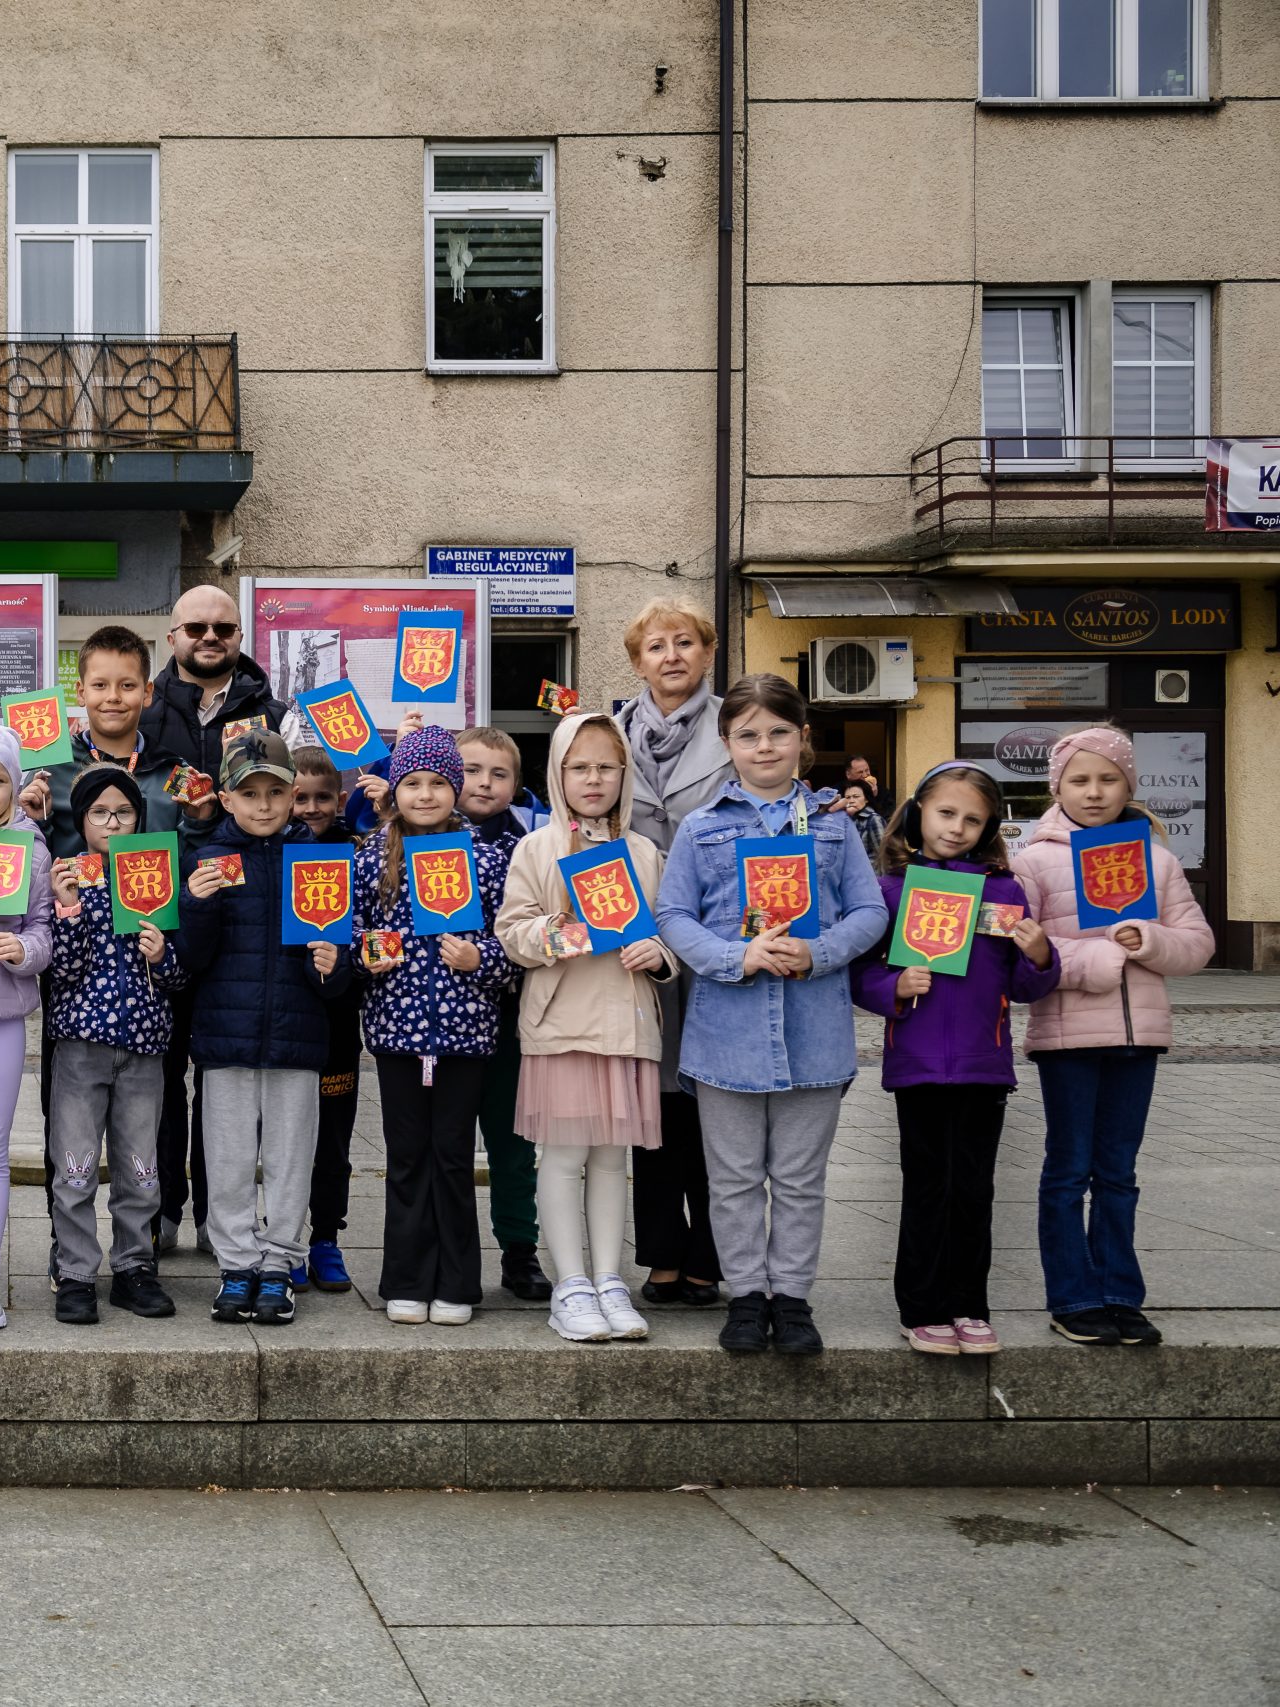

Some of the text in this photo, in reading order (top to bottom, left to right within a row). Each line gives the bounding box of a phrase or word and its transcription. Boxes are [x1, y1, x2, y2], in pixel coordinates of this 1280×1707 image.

[436, 551, 567, 561] GABINET MEDYCYNY
[455, 562, 548, 572] REGULACYJNEJ
[363, 604, 400, 614] Symbole
[1072, 609, 1150, 627] SANTOS
[1172, 608, 1230, 626] LODY
[1082, 630, 1108, 641] MAREK
[1001, 744, 1053, 759] SANTO
[1138, 774, 1201, 788] CIASTA
[1149, 801, 1188, 810] SANTOS
[1158, 823, 1194, 836] DY
[321, 1072, 355, 1084] MARVEL
[321, 1081, 354, 1094] COMICS
